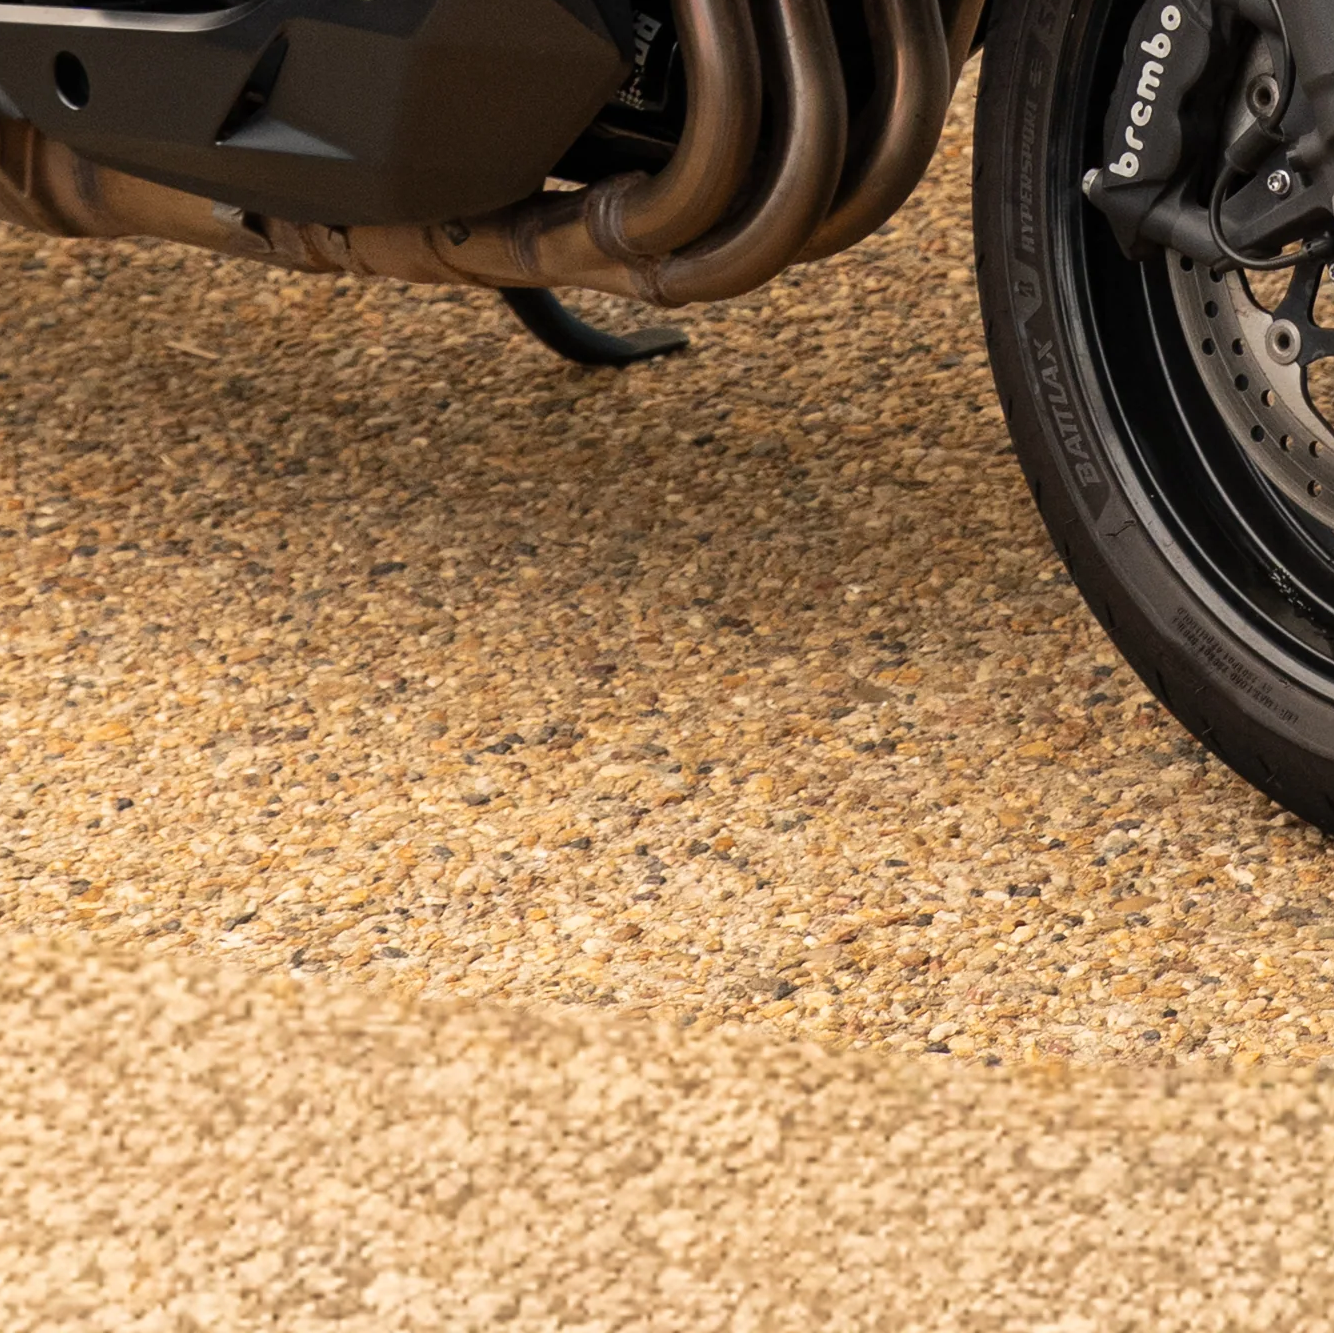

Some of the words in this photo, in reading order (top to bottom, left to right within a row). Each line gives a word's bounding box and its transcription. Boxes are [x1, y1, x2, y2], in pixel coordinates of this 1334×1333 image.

[1108, 4, 1182, 179] brembo
[1020, 95, 1037, 253] HYPERSPORT
[1032, 337, 1102, 488] BATTLAX
